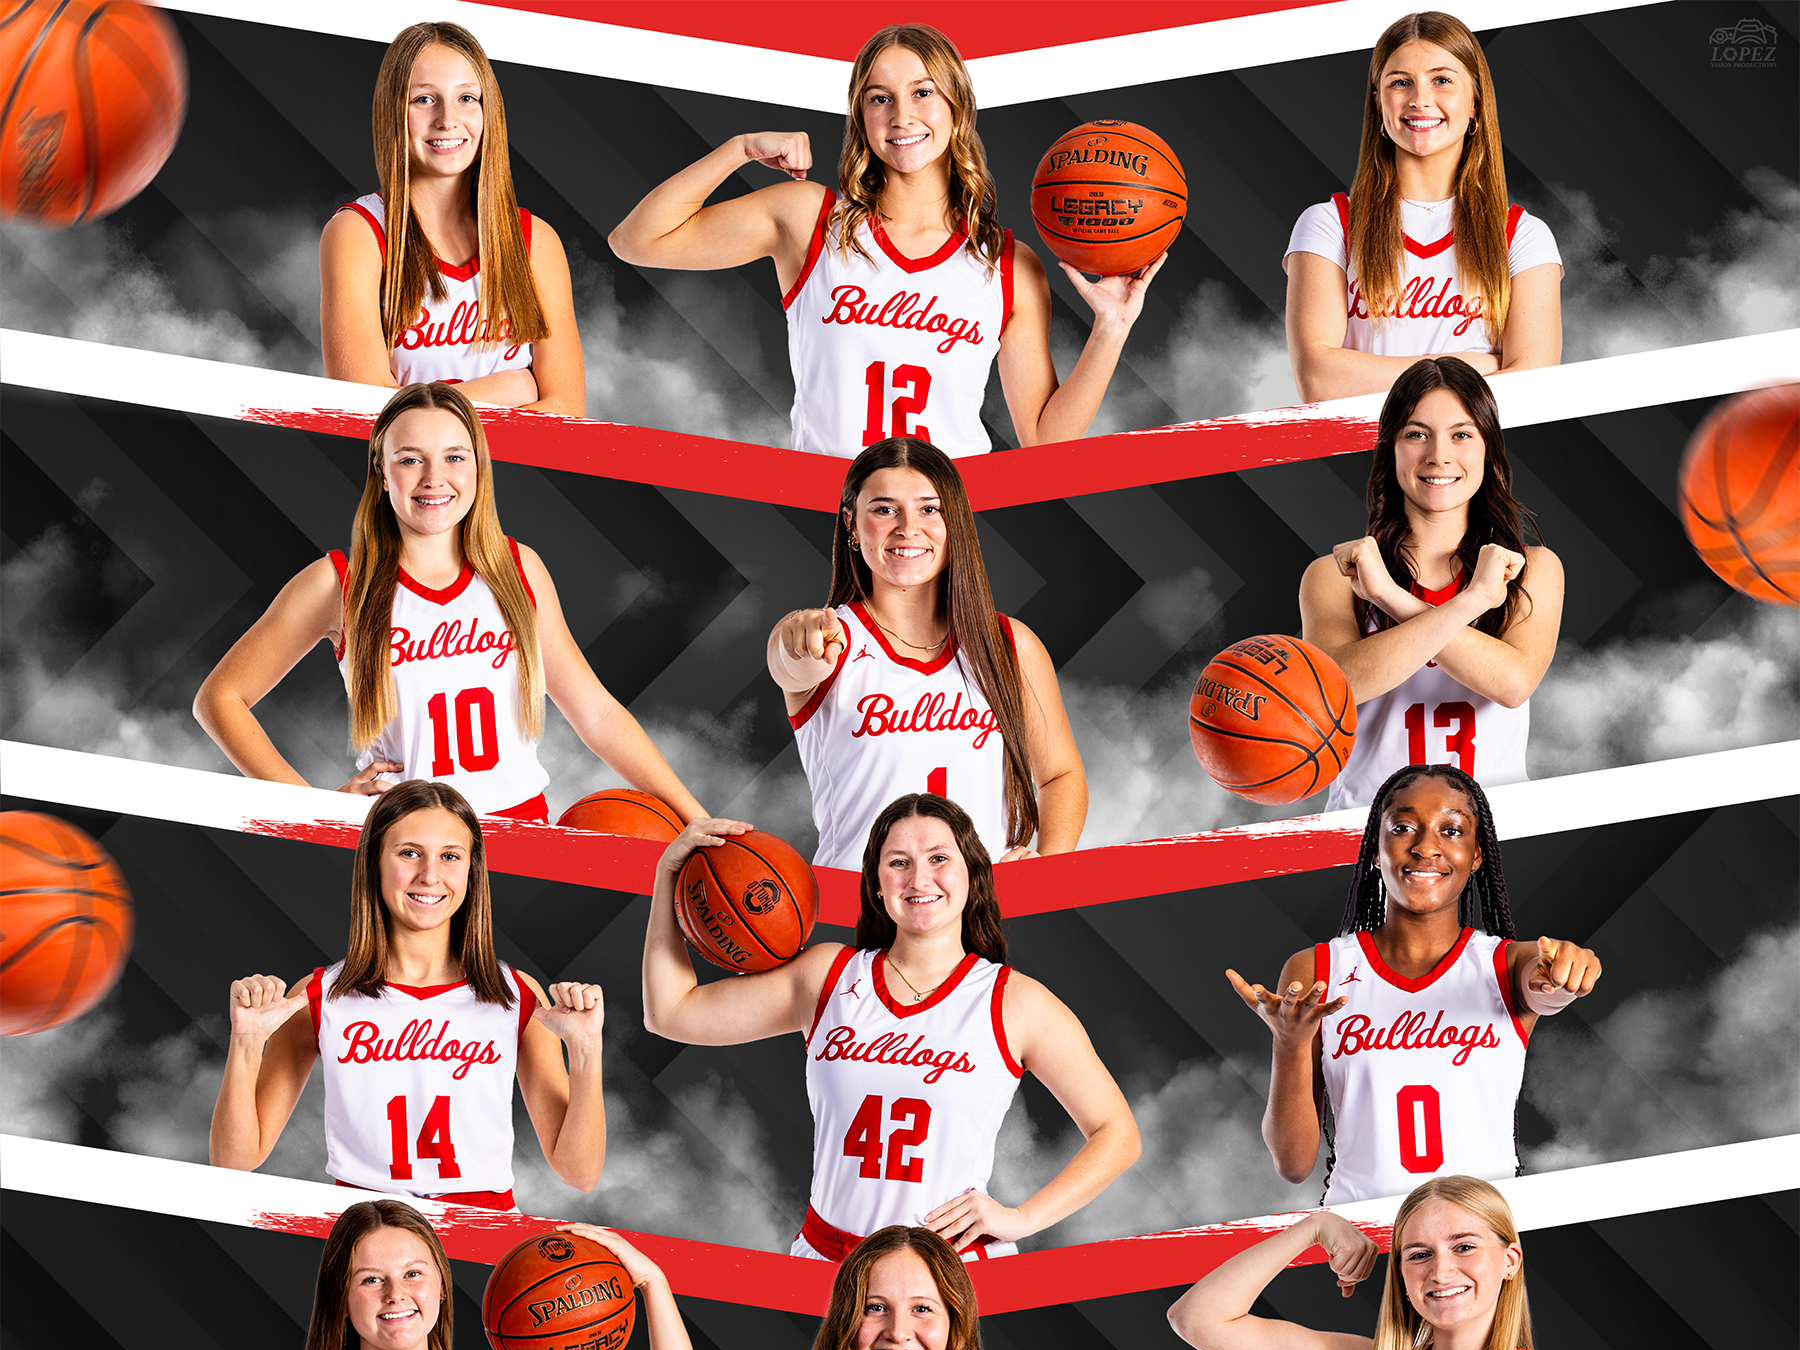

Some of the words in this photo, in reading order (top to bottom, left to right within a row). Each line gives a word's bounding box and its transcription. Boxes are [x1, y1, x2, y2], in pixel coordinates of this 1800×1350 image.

[1046, 149, 1149, 178] SPALDING
[1051, 196, 1143, 216] LEGACY
[1076, 216, 1135, 227] 1000
[822, 285, 984, 354] Bulldogs
[862, 360, 932, 447] 12
[390, 617, 518, 669] Bulldog
[427, 686, 499, 778] 10
[851, 692, 1003, 750] Bulldog
[1404, 701, 1476, 780] 13
[688, 879, 753, 964] SPALDING
[746, 880, 775, 915] OTTUMWA
[337, 1018, 502, 1081] Bulldogs
[815, 1025, 976, 1085] Bulldogs
[1332, 1010, 1500, 1067] Bulldogs
[387, 1095, 462, 1180] 14
[843, 1094, 932, 1183] 42
[1396, 1084, 1444, 1174] 0
[538, 1239, 576, 1259] OTTUMWA
[527, 1276, 624, 1328] SPALDING
